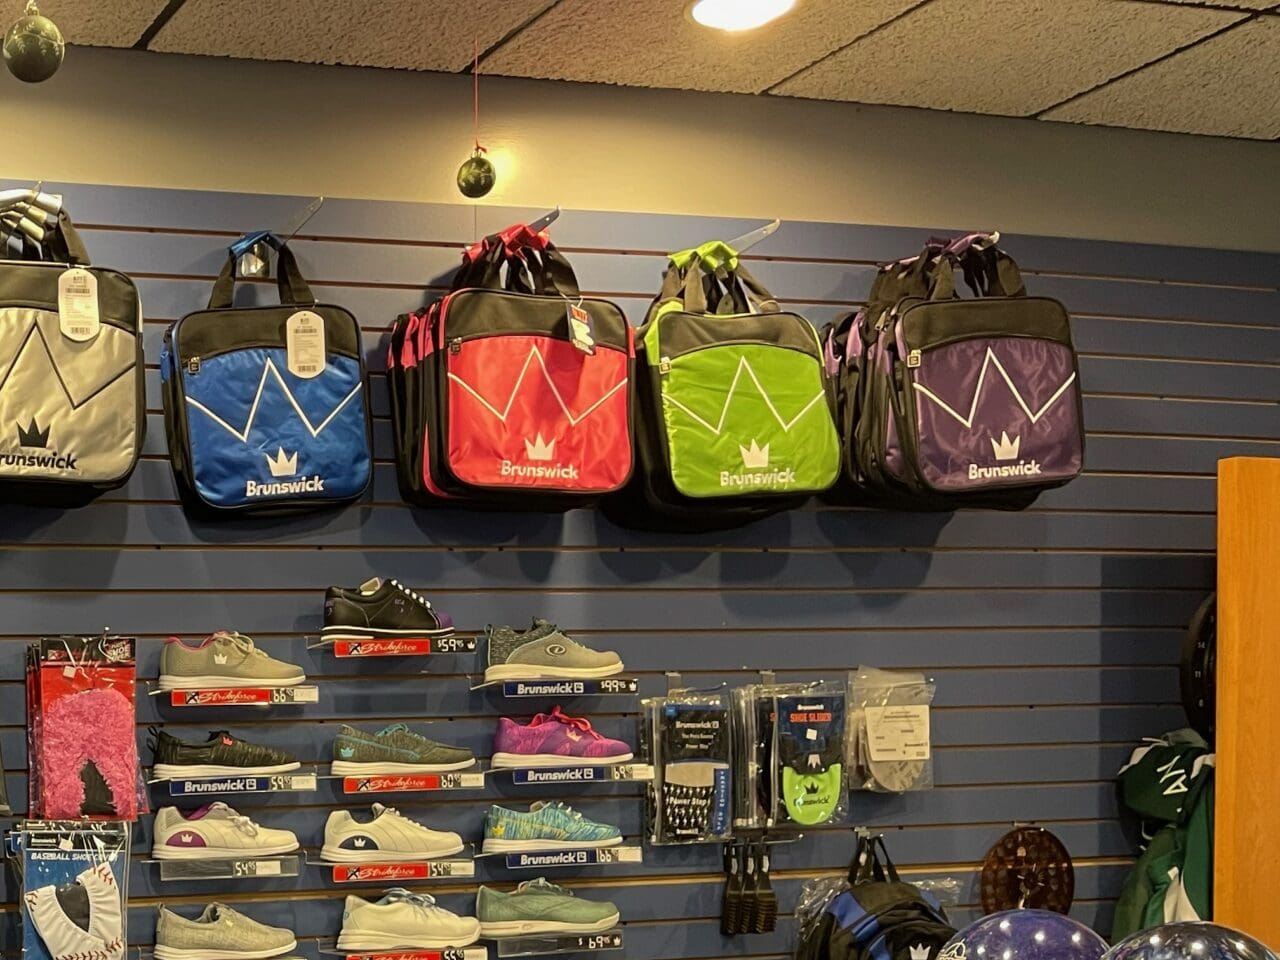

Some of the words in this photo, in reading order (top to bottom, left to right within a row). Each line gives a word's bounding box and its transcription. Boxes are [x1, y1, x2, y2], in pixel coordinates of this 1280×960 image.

[501, 460, 579, 480] Brunswick
[968, 459, 1042, 481] Brunswick
[720, 467, 796, 489] Brunswick
[245, 475, 325, 497] Brunswick
[359, 641, 417, 655] Strikeforce
[517, 682, 575, 694] Brunswick
[199, 690, 257, 703] Strikeforce
[676, 721, 711, 729] Brunswick
[527, 769, 582, 781] Brunswick
[184, 781, 246, 793] Brunswick
[369, 776, 427, 790] Strikeforce
[31, 852, 70, 860] BASEBALL
[520, 852, 577, 865] Brunswick
[359, 866, 416, 879] Strikeforce
